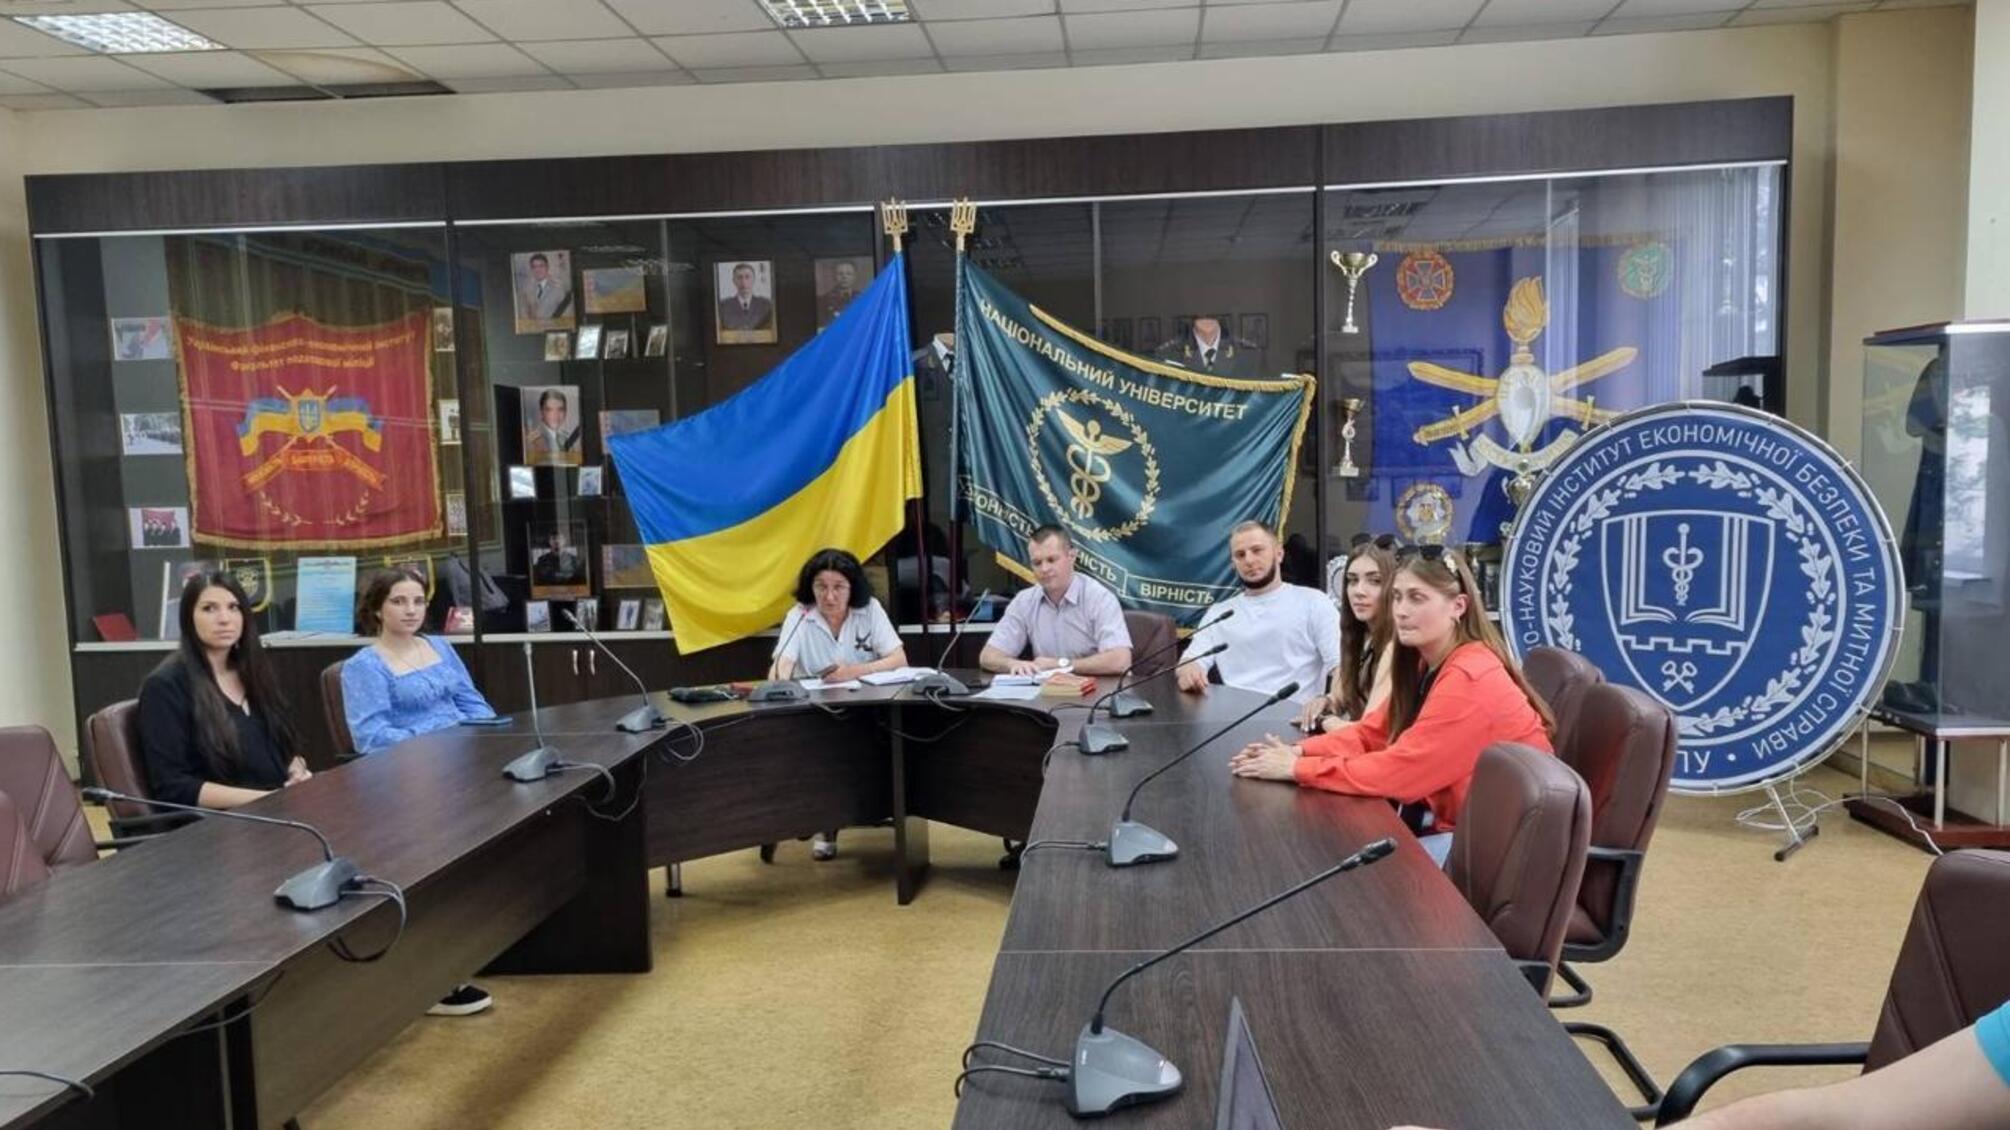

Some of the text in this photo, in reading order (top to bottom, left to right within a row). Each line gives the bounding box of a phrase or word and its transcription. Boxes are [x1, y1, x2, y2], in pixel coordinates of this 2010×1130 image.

[980, 299, 1249, 421] НАЦІОНАЛЬНИЙ УНІВЕРСИТЕТ
[1547, 435, 1632, 512] ІНСТИТУТ
[1638, 423, 1803, 471] ЕКОНОМІЧНОЇ
[1795, 462, 1873, 562] БЕЗПЕКИ
[1078, 551, 1117, 582] НІСТЬ
[1140, 583, 1216, 605] ВІРНІСТЬ
[1518, 507, 1556, 651] О-НАУКОВИЙ
[1853, 566, 1877, 597] ТА
[1828, 602, 1877, 699] МИТНОЇ
[1751, 691, 1839, 760] СПРАВИ
